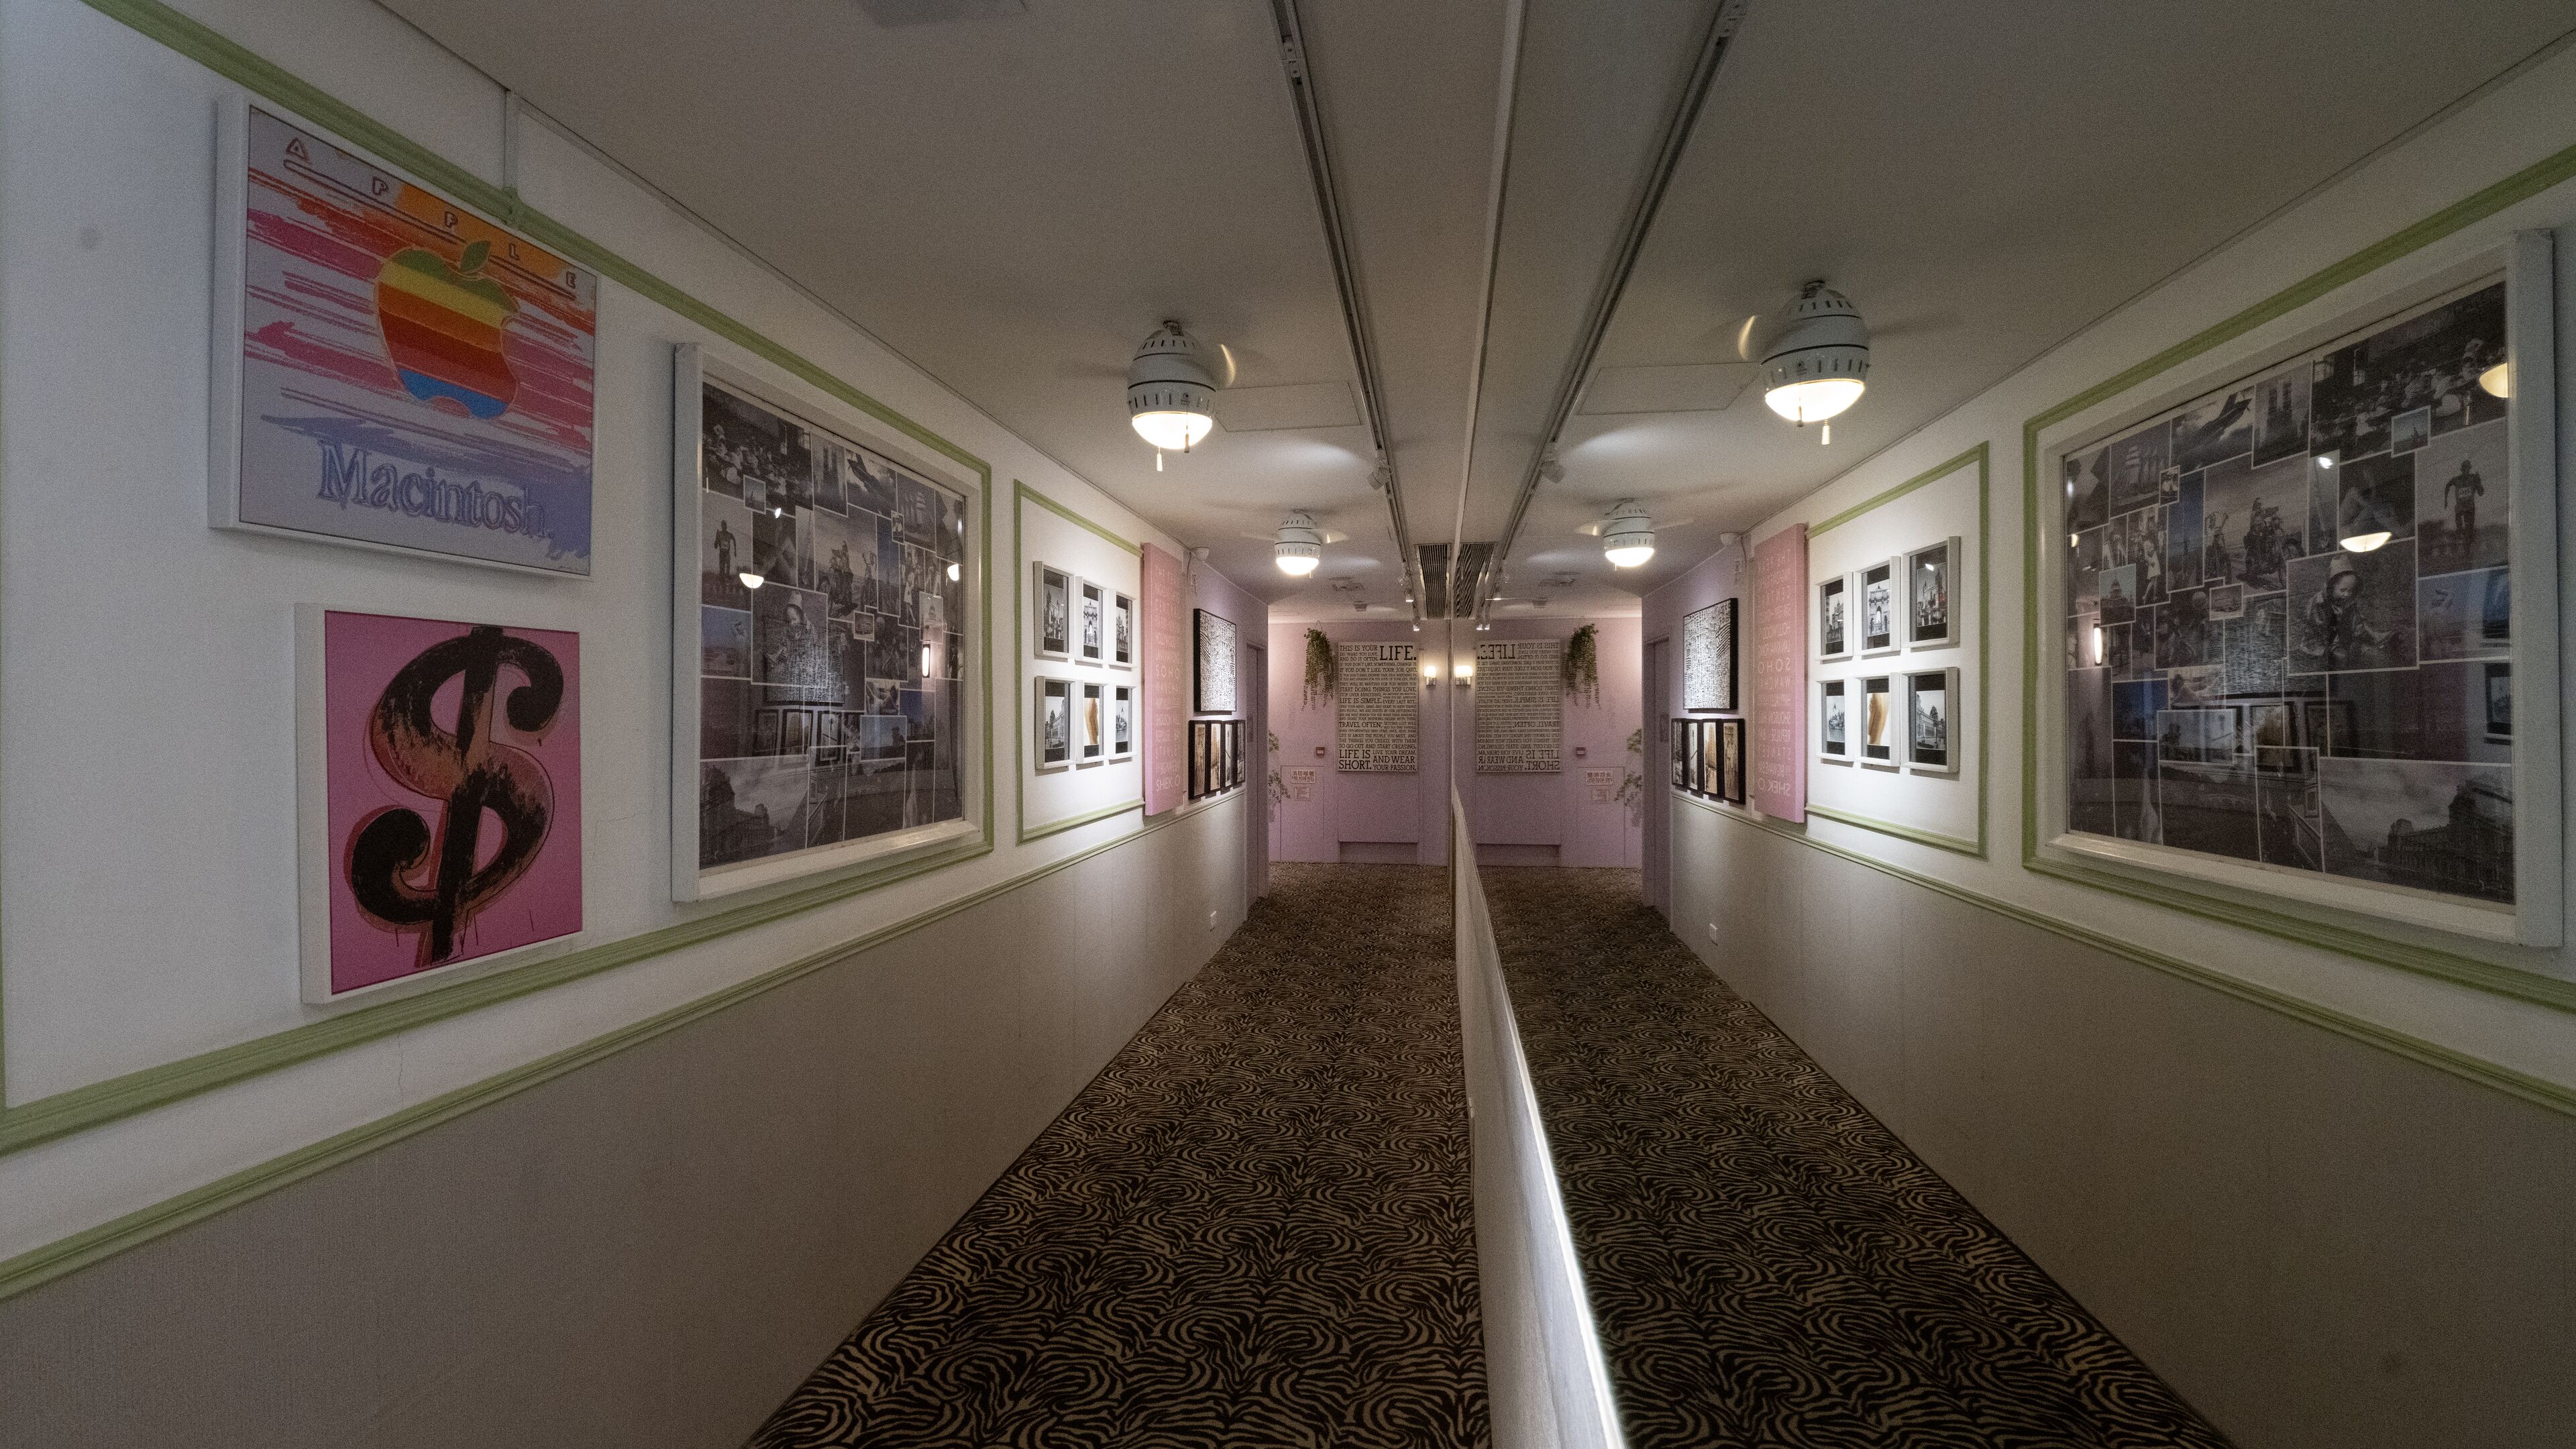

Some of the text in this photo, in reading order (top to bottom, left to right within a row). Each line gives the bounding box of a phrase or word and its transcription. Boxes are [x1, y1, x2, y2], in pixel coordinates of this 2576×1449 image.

[1380, 646, 1416, 660] LIFE.
[1155, 665, 1180, 679] SOHO
[1339, 750, 1371, 758] LIFE IS
[1339, 760, 1371, 769] SHORT.
[1156, 777, 1173, 792] SHEK
